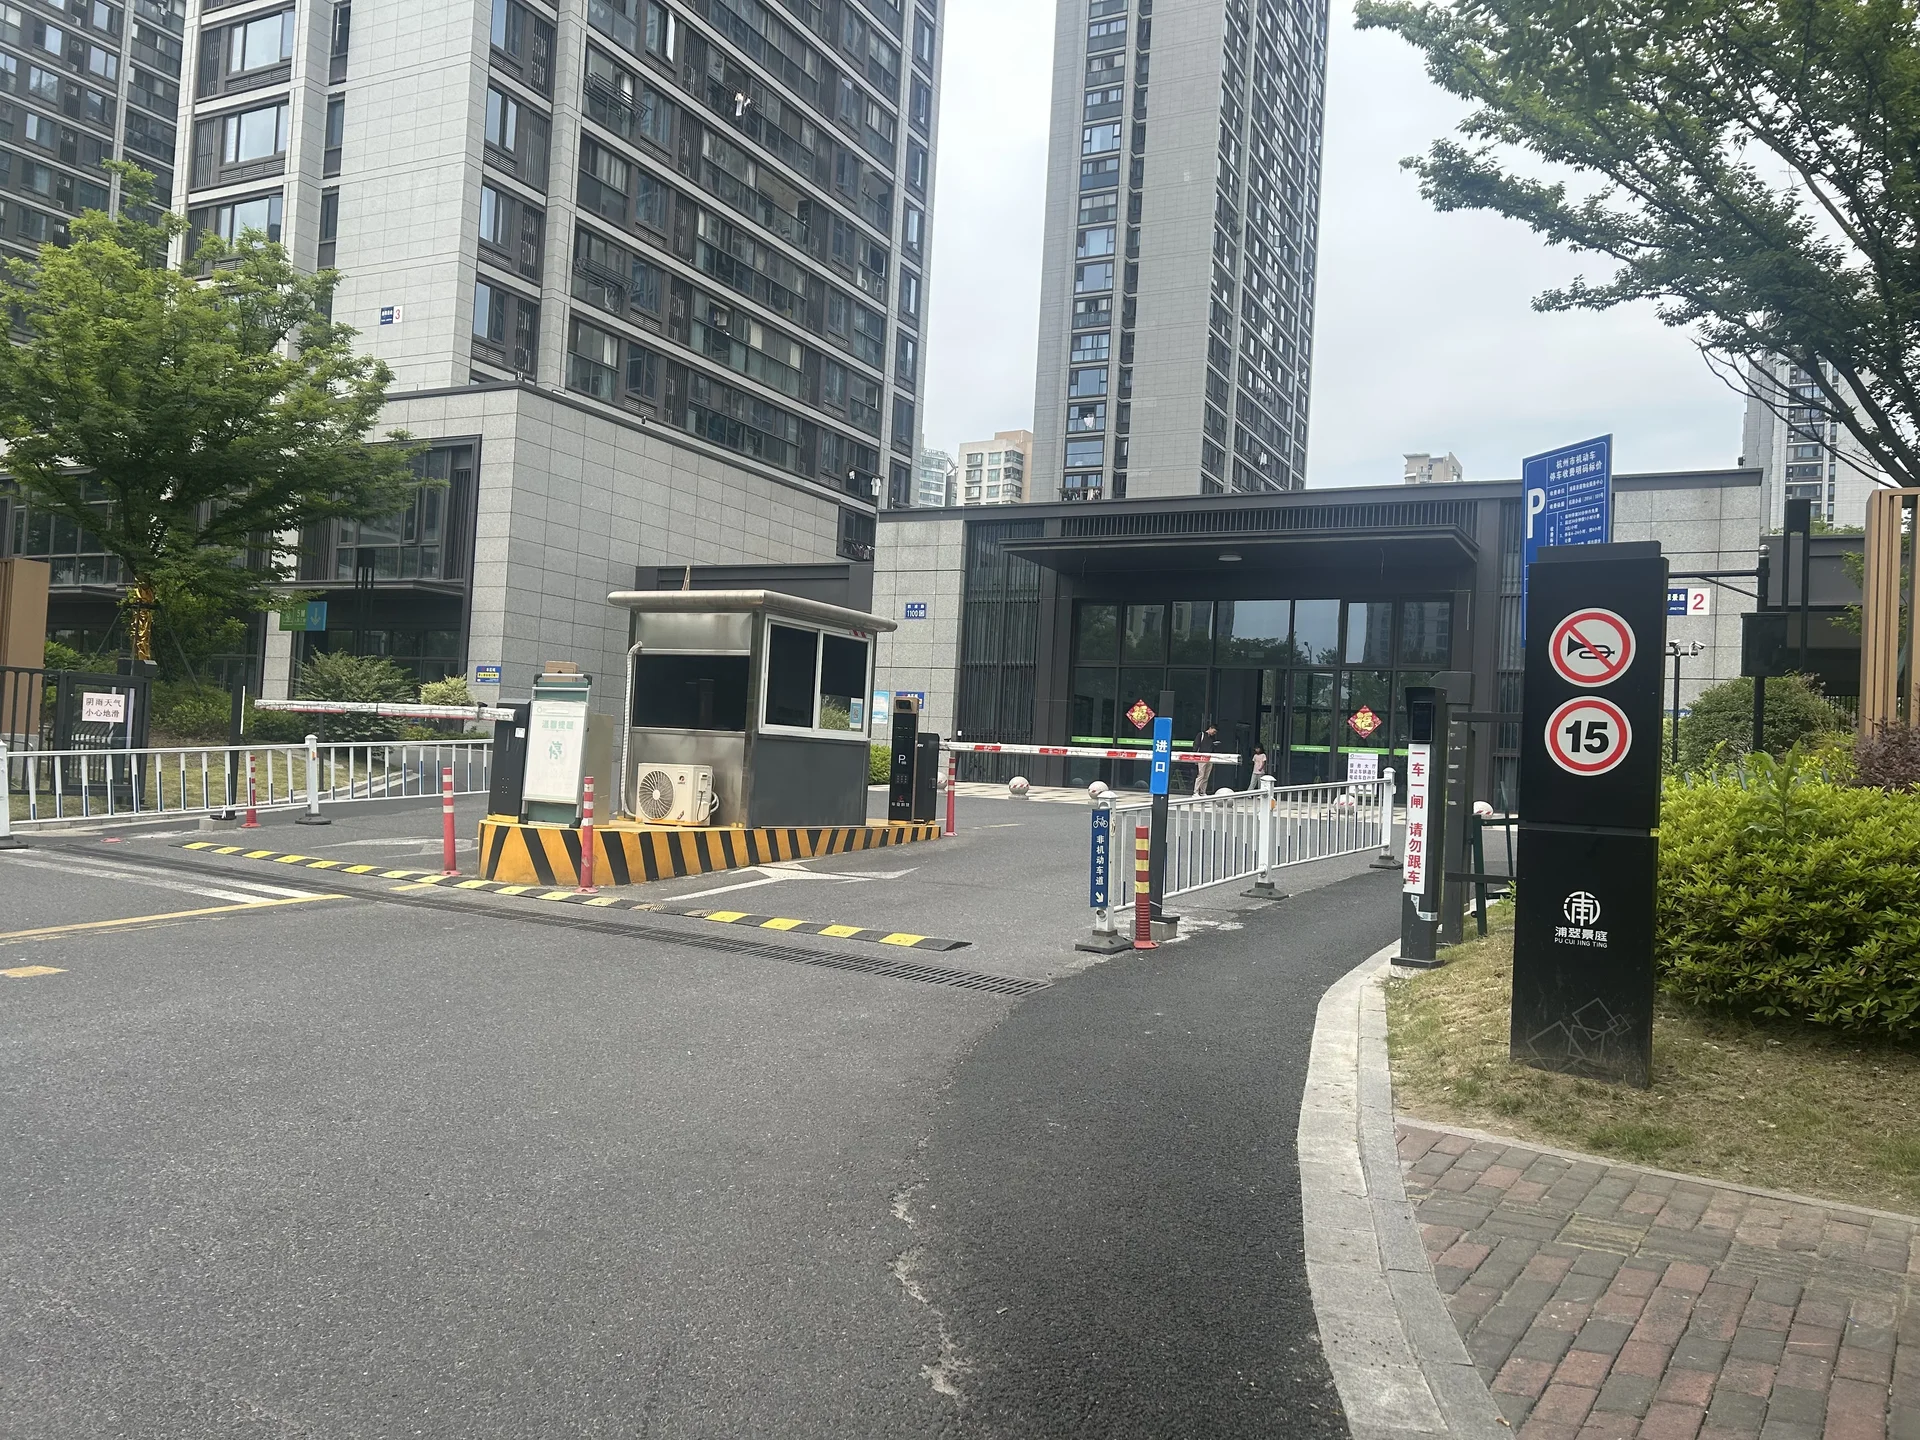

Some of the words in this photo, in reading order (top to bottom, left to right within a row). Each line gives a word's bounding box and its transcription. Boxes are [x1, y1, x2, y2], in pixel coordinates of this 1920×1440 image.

[395, 309, 401, 319] 3
[1556, 450, 1597, 470] 杭州市机动车
[1549, 460, 1603, 481] 停车收费明码标价
[1527, 487, 1546, 539] P
[1692, 593, 1704, 610] 2
[85, 697, 122, 708] 阴雨天气
[85, 708, 120, 718] 小心地滑
[1565, 720, 1610, 754] 15
[898, 754, 906, 764] P
[1155, 740, 1168, 773] 进口
[1410, 752, 1426, 810] 一车一闸
[1095, 835, 1105, 886] 非机动车道
[1407, 822, 1424, 885] 请勿跟车
[1555, 926, 1608, 942] 浦翠景庭
